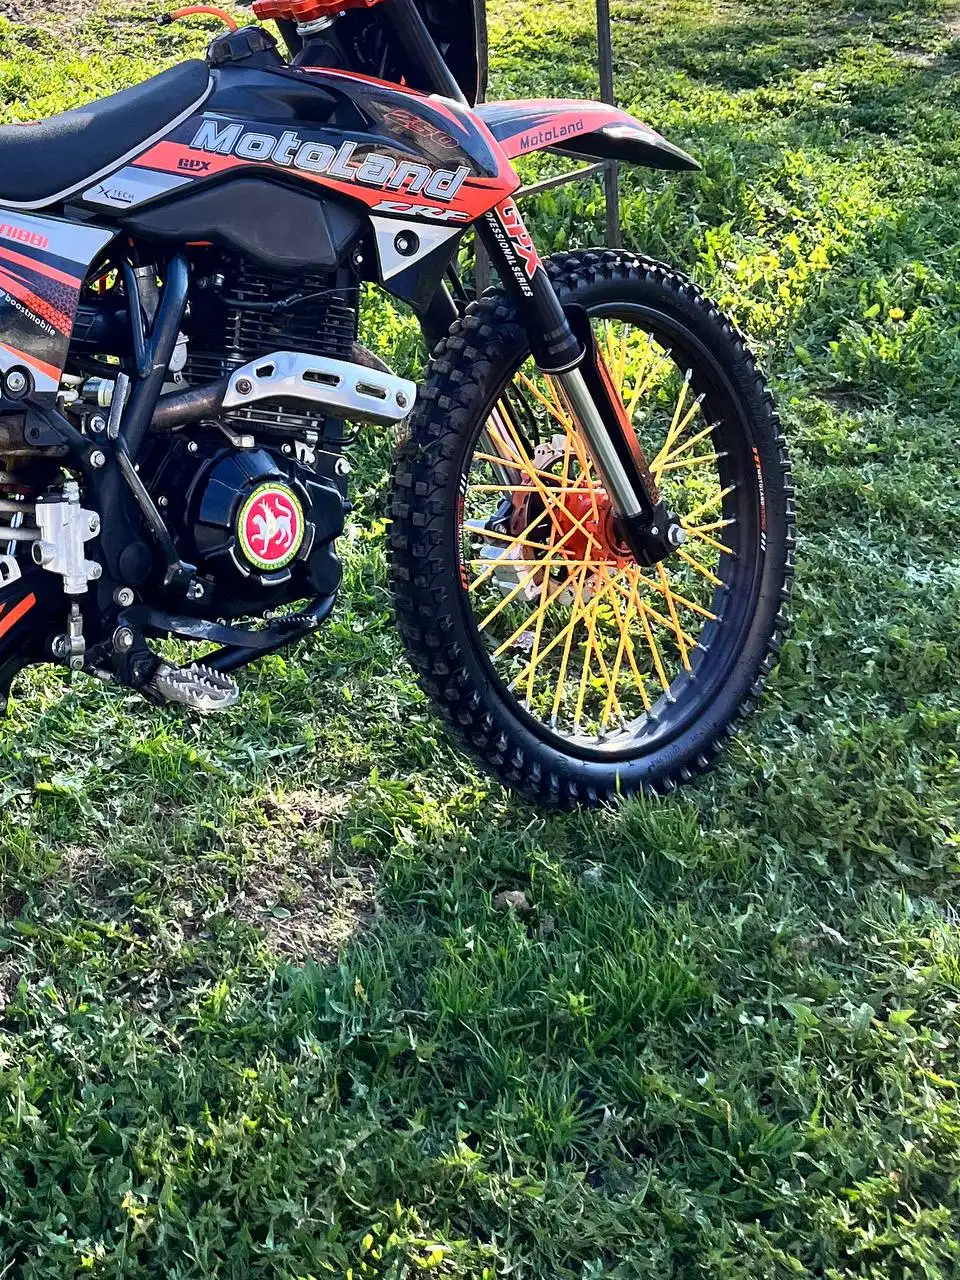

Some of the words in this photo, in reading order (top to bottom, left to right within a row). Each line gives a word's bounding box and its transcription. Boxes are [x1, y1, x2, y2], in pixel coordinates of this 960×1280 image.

[189, 120, 472, 204] MotoLand
[520, 119, 584, 150] MotoLand
[485, 211, 516, 266] OFESSIONAL
[511, 266, 534, 297] SERIES
[4, 292, 56, 337] boostmobile
